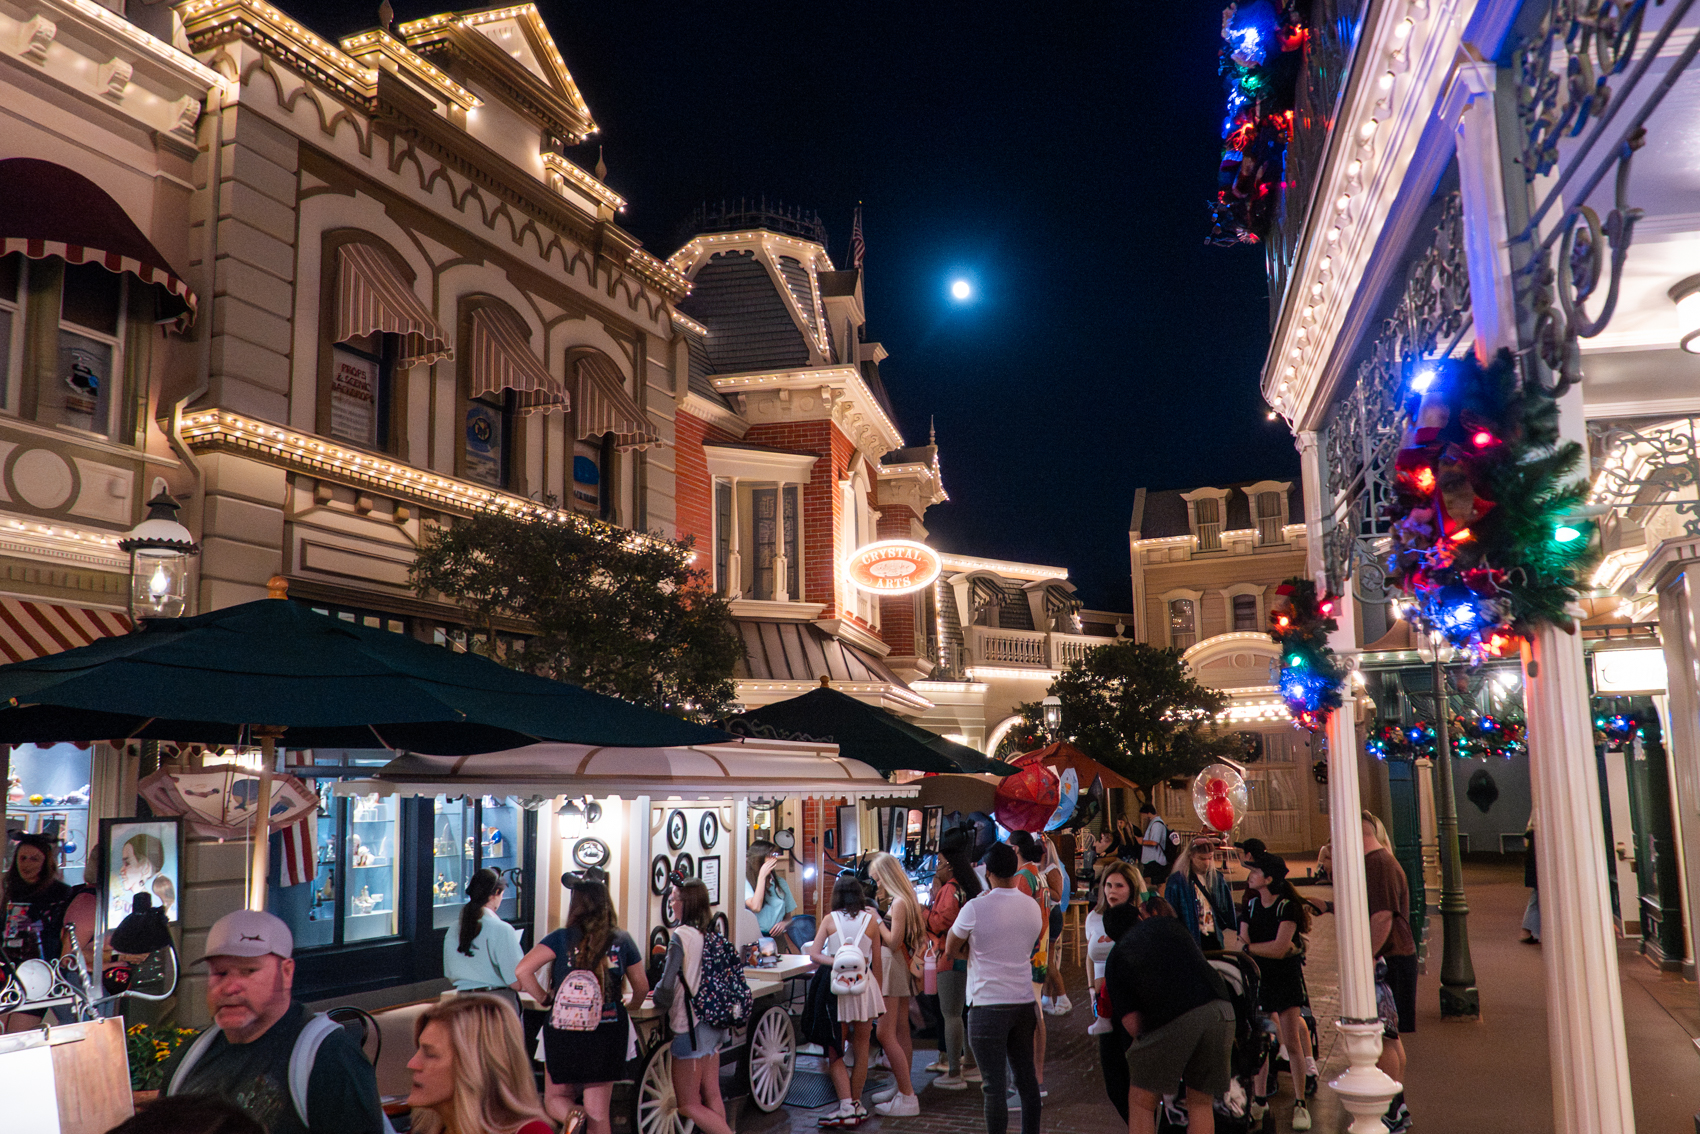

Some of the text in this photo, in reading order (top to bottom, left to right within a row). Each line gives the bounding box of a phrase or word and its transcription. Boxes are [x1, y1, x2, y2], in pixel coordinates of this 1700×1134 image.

[341, 363, 367, 380] PROPS
[861, 547, 922, 565] CRYSTAL
[875, 576, 912, 588] ARTS
